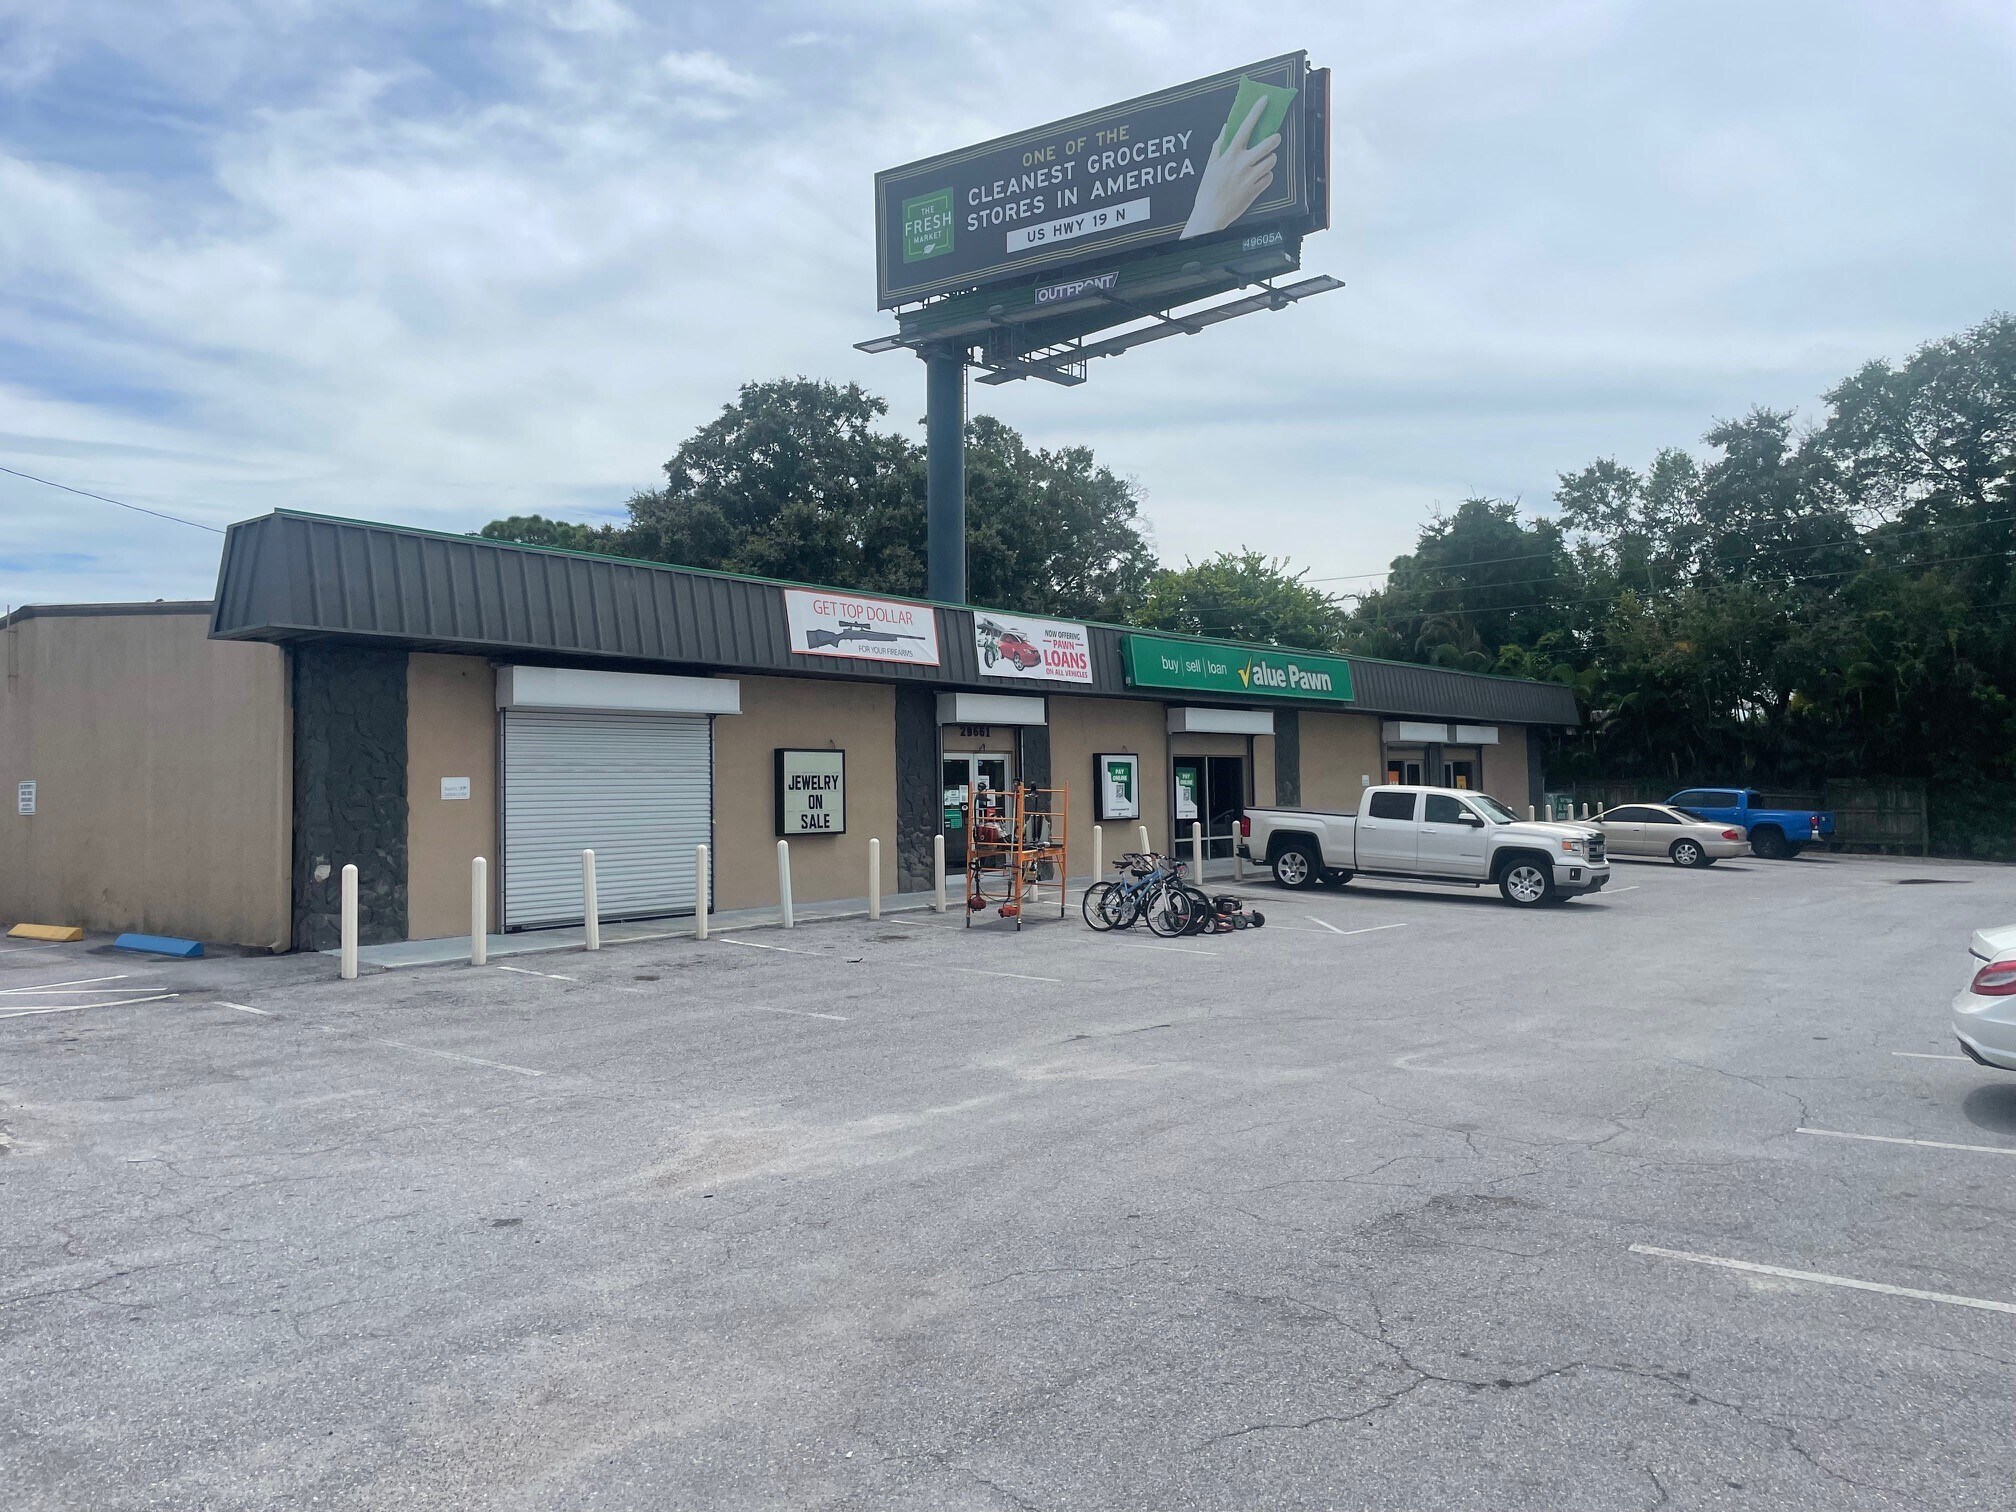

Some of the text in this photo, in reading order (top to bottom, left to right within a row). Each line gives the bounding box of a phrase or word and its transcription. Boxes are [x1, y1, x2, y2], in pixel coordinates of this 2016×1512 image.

[1022, 125, 1130, 167] ONE OF THE
[968, 130, 1193, 206] CLEANEST GROCERY
[967, 158, 1195, 231] STORES IN AMERICA
[920, 205, 935, 216] THE
[905, 211, 952, 237] FRESH
[1027, 208, 1126, 243] US HWY 19 N
[913, 231, 942, 244] MARKET
[1244, 231, 1283, 248] 49605A
[813, 600, 913, 626] GET TOP DOLLAR
[1044, 629, 1080, 641] NOW OFFERING
[858, 644, 913, 658] FOR YOUR FIREARMS
[1053, 639, 1075, 650] PAWN
[1043, 649, 1087, 670] LOANS
[1064, 670, 1088, 679] VEHICLES
[1161, 655, 1179, 674] buy
[1185, 659, 1201, 673] sell
[1207, 661, 1228, 675] loan
[1288, 664, 1332, 692] Pawn
[788, 775, 839, 791] JEWELRY
[808, 794, 823, 810] ON
[801, 813, 830, 830] SALE
